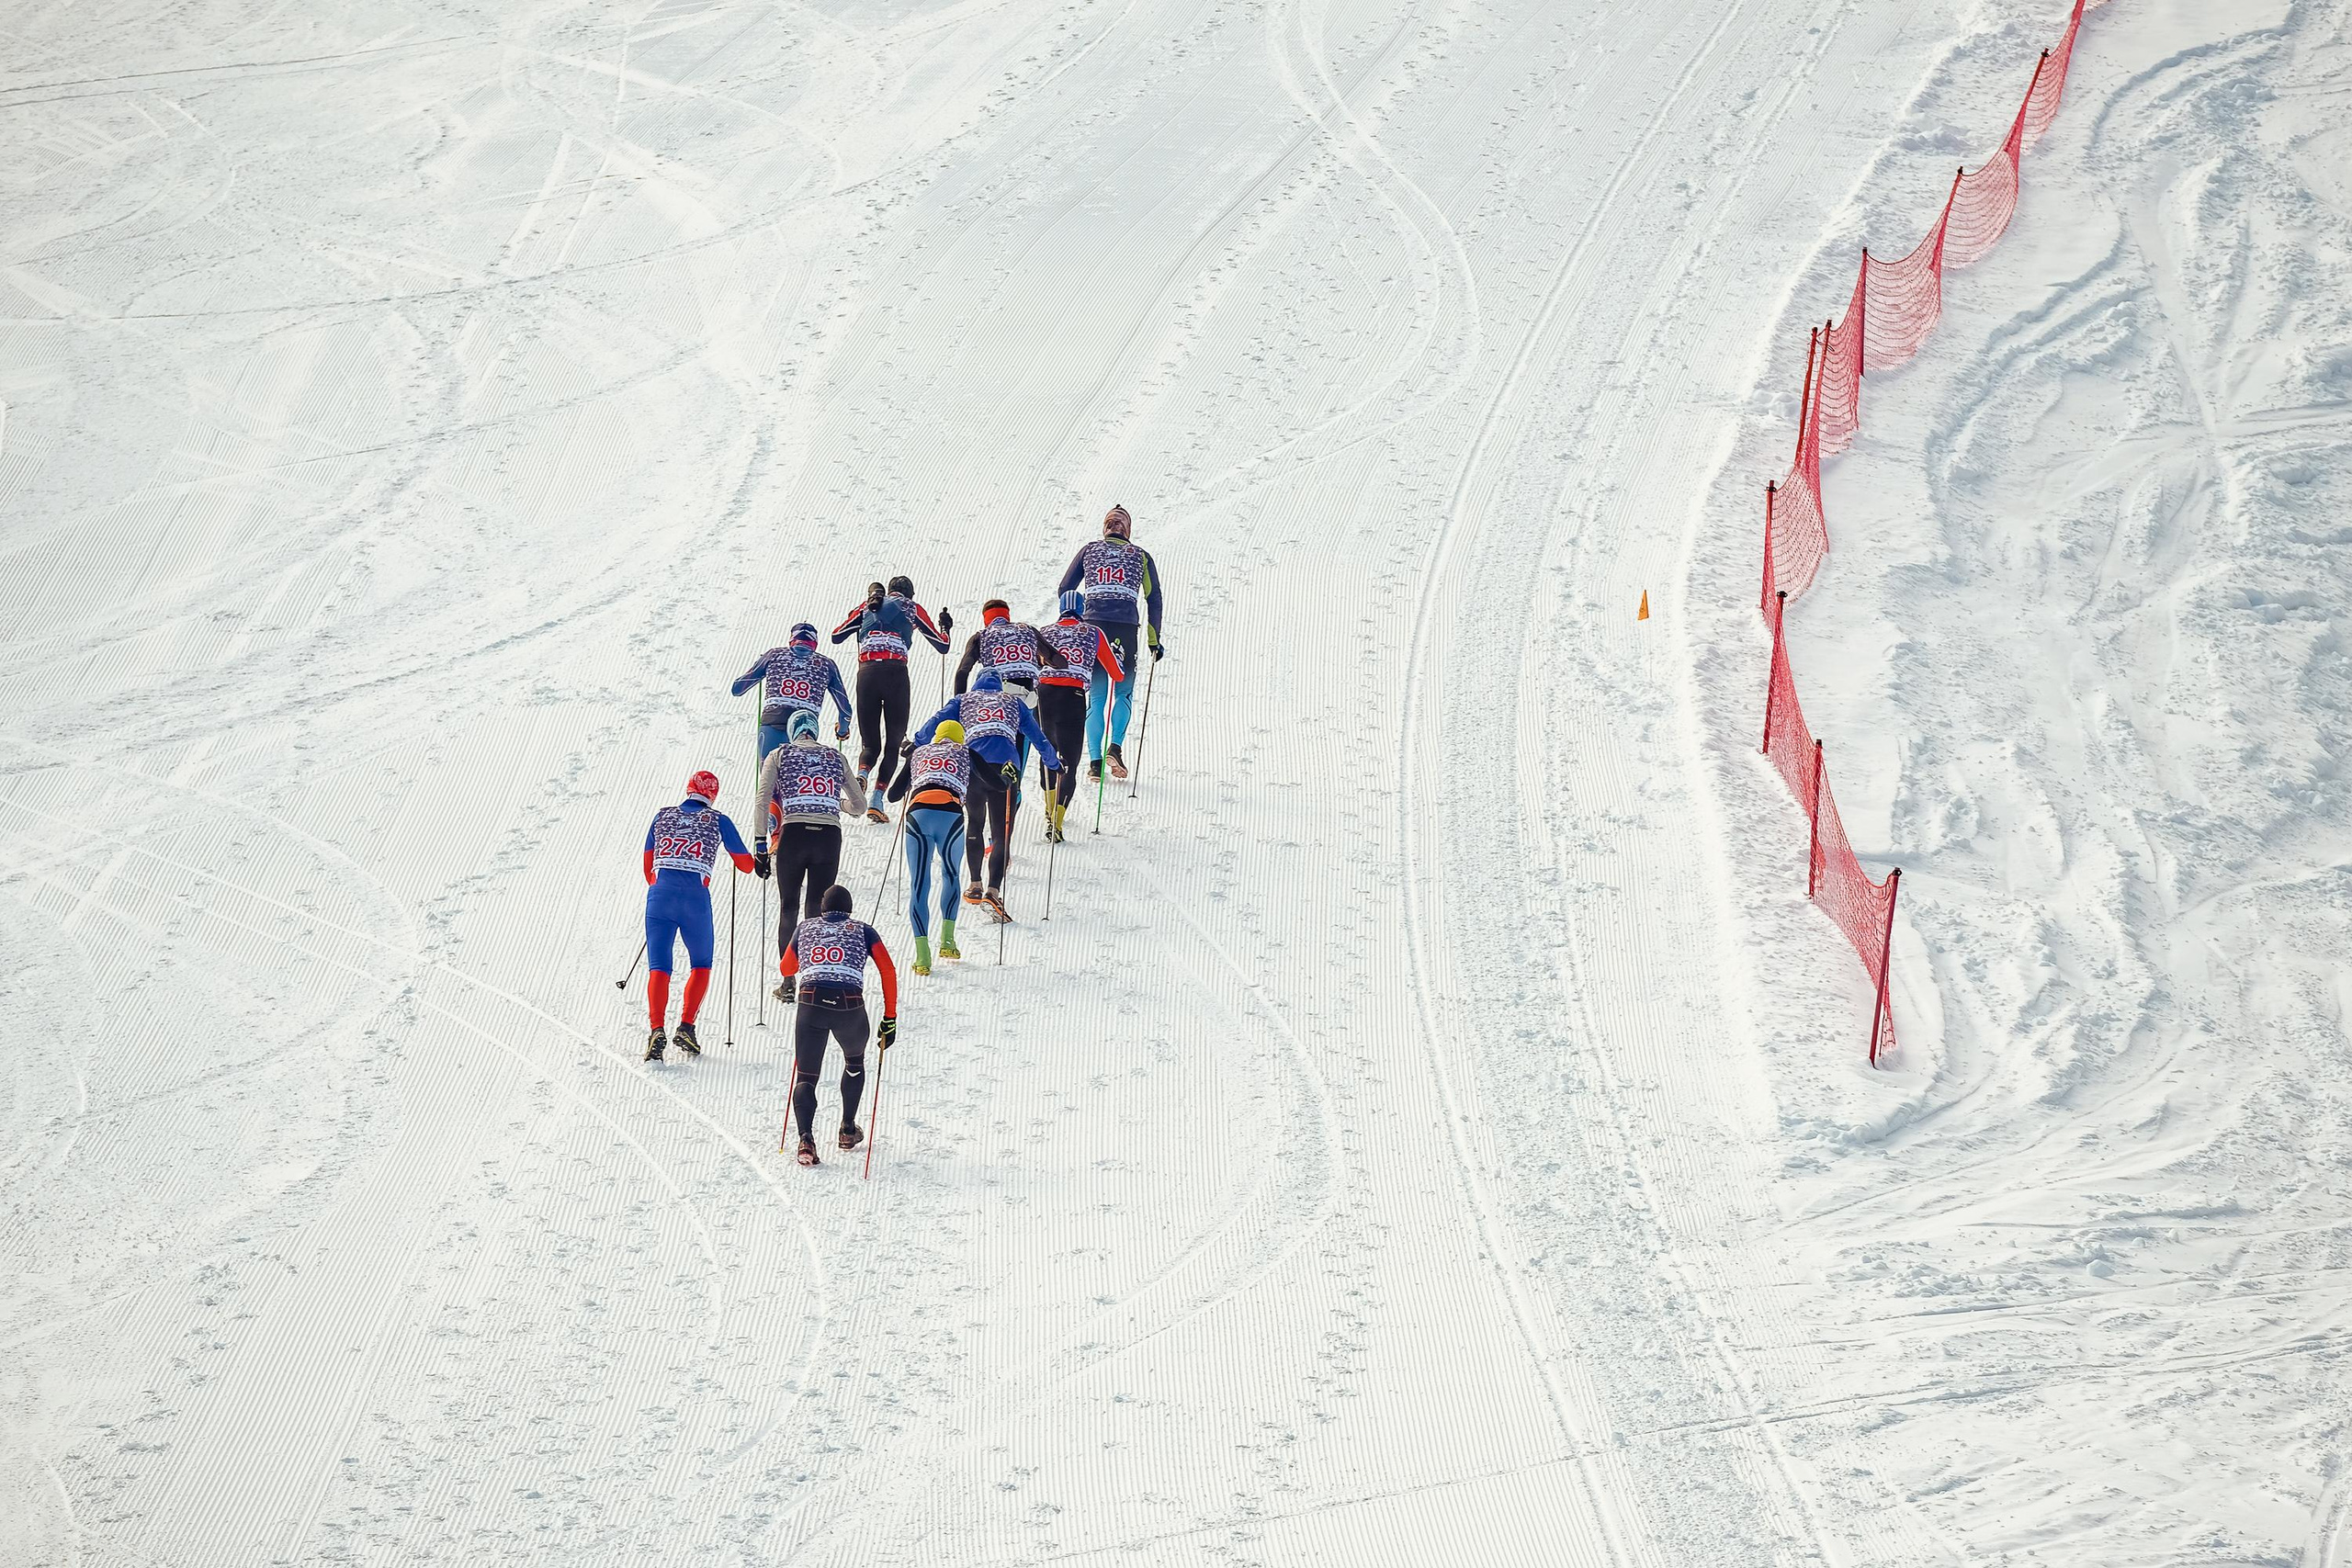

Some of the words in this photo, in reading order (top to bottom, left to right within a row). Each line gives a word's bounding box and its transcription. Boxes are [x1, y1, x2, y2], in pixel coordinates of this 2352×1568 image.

[1097, 567, 1125, 584] 114
[992, 644, 1033, 665] 289
[780, 678, 810, 699] 88
[977, 708, 1006, 723] 34
[918, 757, 958, 775] 296
[797, 774, 835, 796] 261
[659, 837, 704, 859] 274
[809, 946, 845, 965] 80
